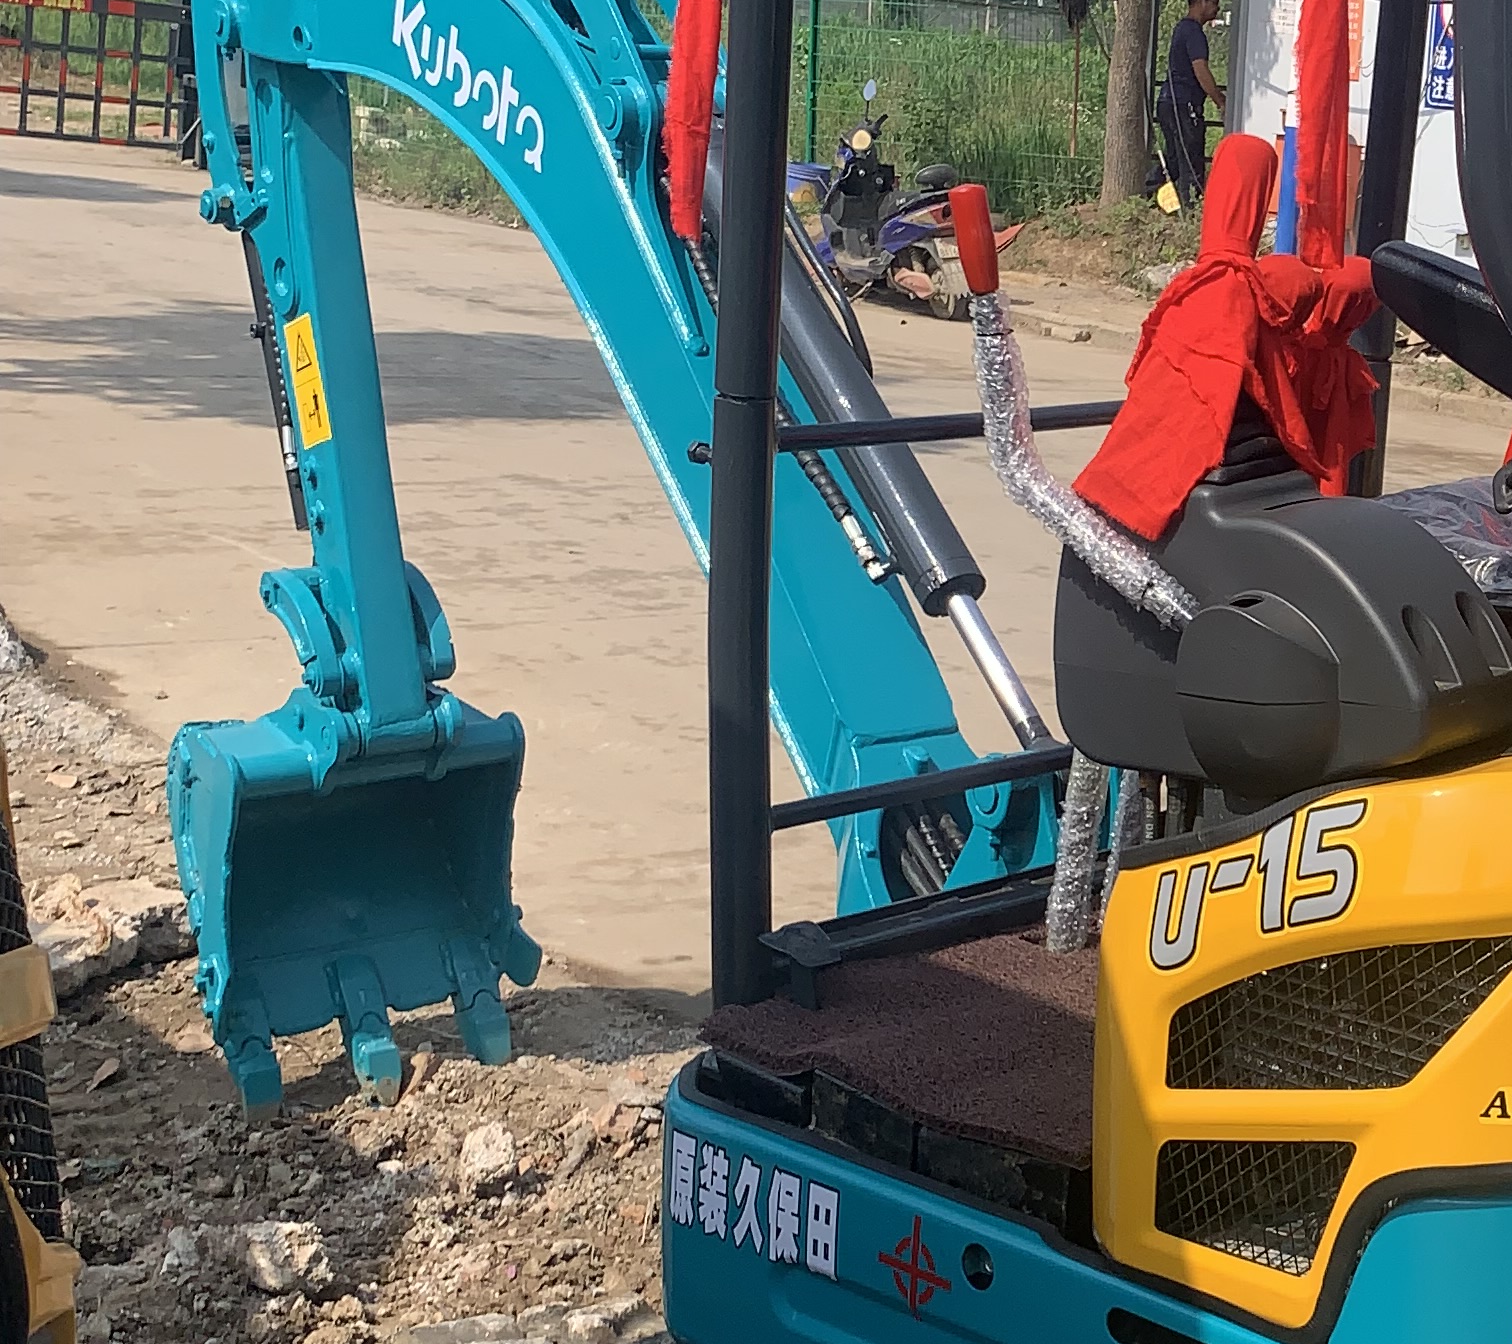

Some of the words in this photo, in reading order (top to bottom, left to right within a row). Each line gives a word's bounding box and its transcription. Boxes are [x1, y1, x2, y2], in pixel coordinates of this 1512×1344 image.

[1149, 798, 1369, 971] U-15
[669, 1129, 840, 1282] 原装久保田
